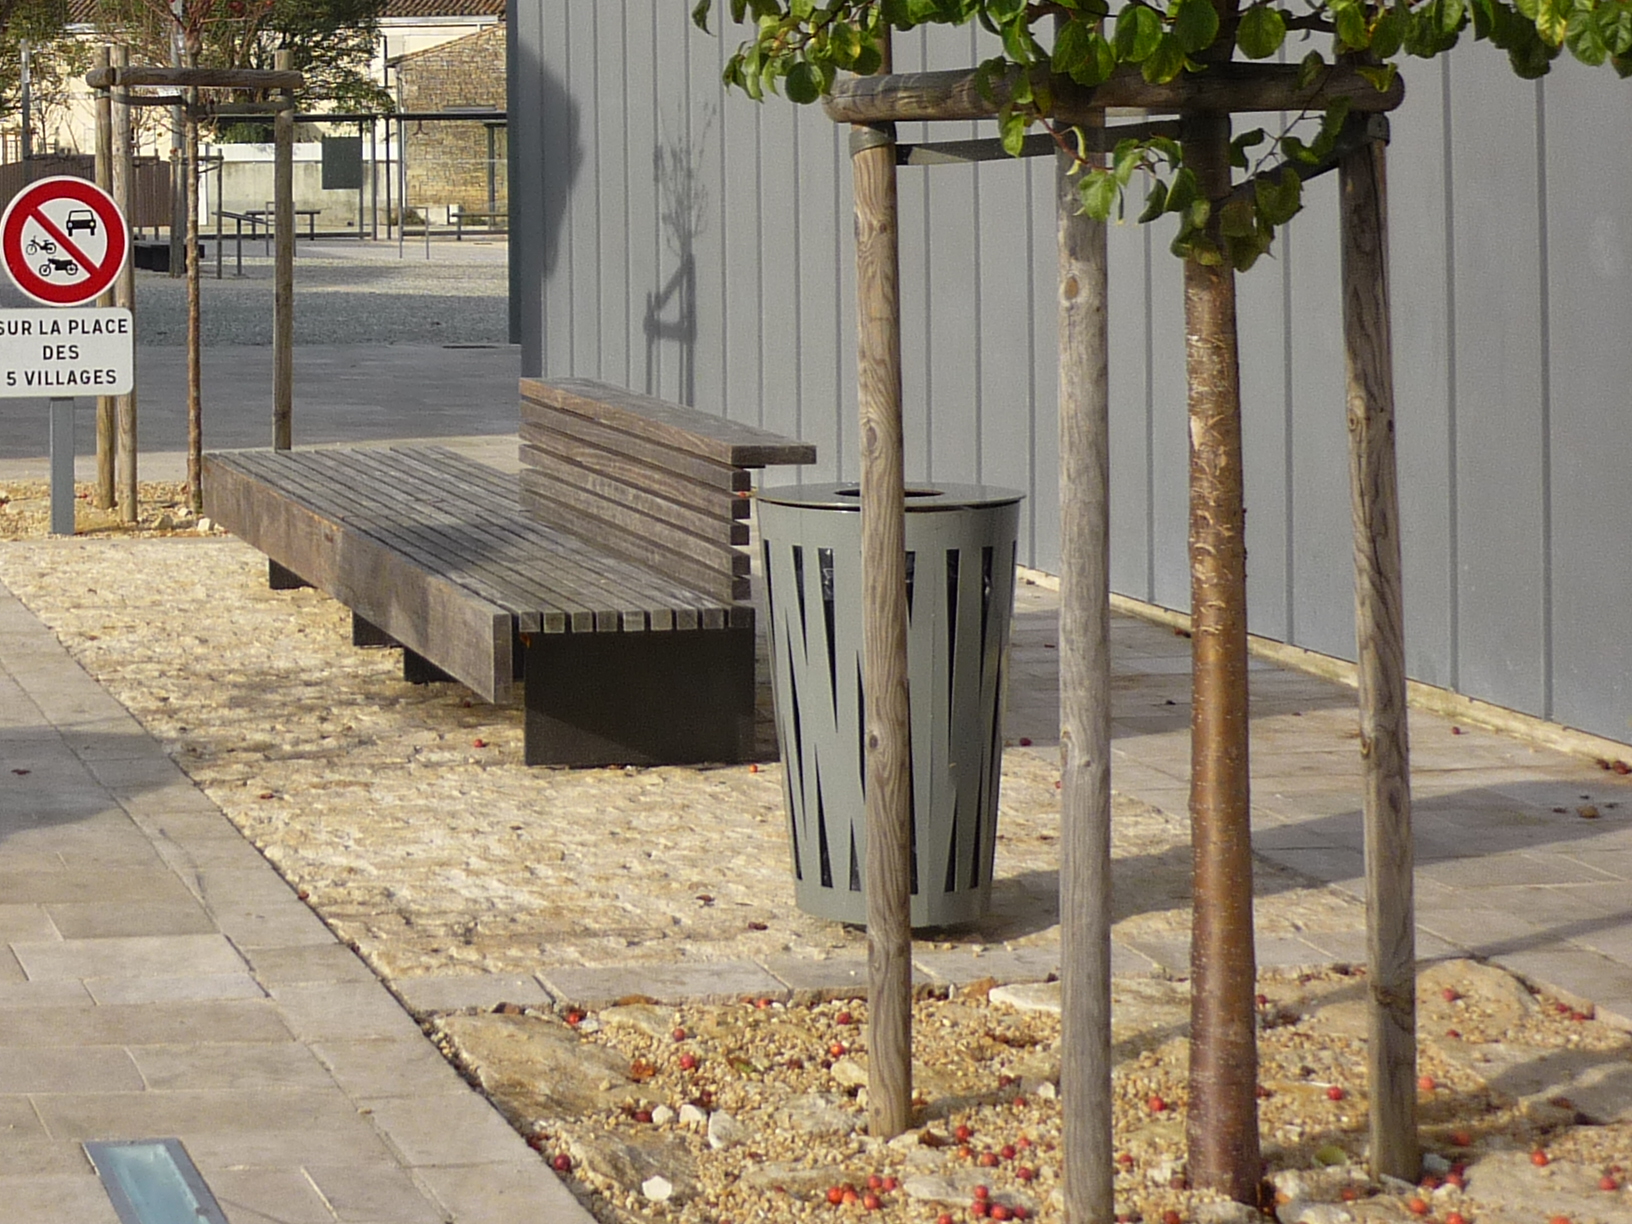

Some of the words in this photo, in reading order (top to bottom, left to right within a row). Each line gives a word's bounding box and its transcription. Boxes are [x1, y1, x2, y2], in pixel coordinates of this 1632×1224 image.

[39, 319, 61, 335] LA
[68, 318, 128, 335] PLACE
[42, 344, 80, 360] DES
[6, 370, 17, 386] 5
[24, 369, 117, 386] VILLAGES
